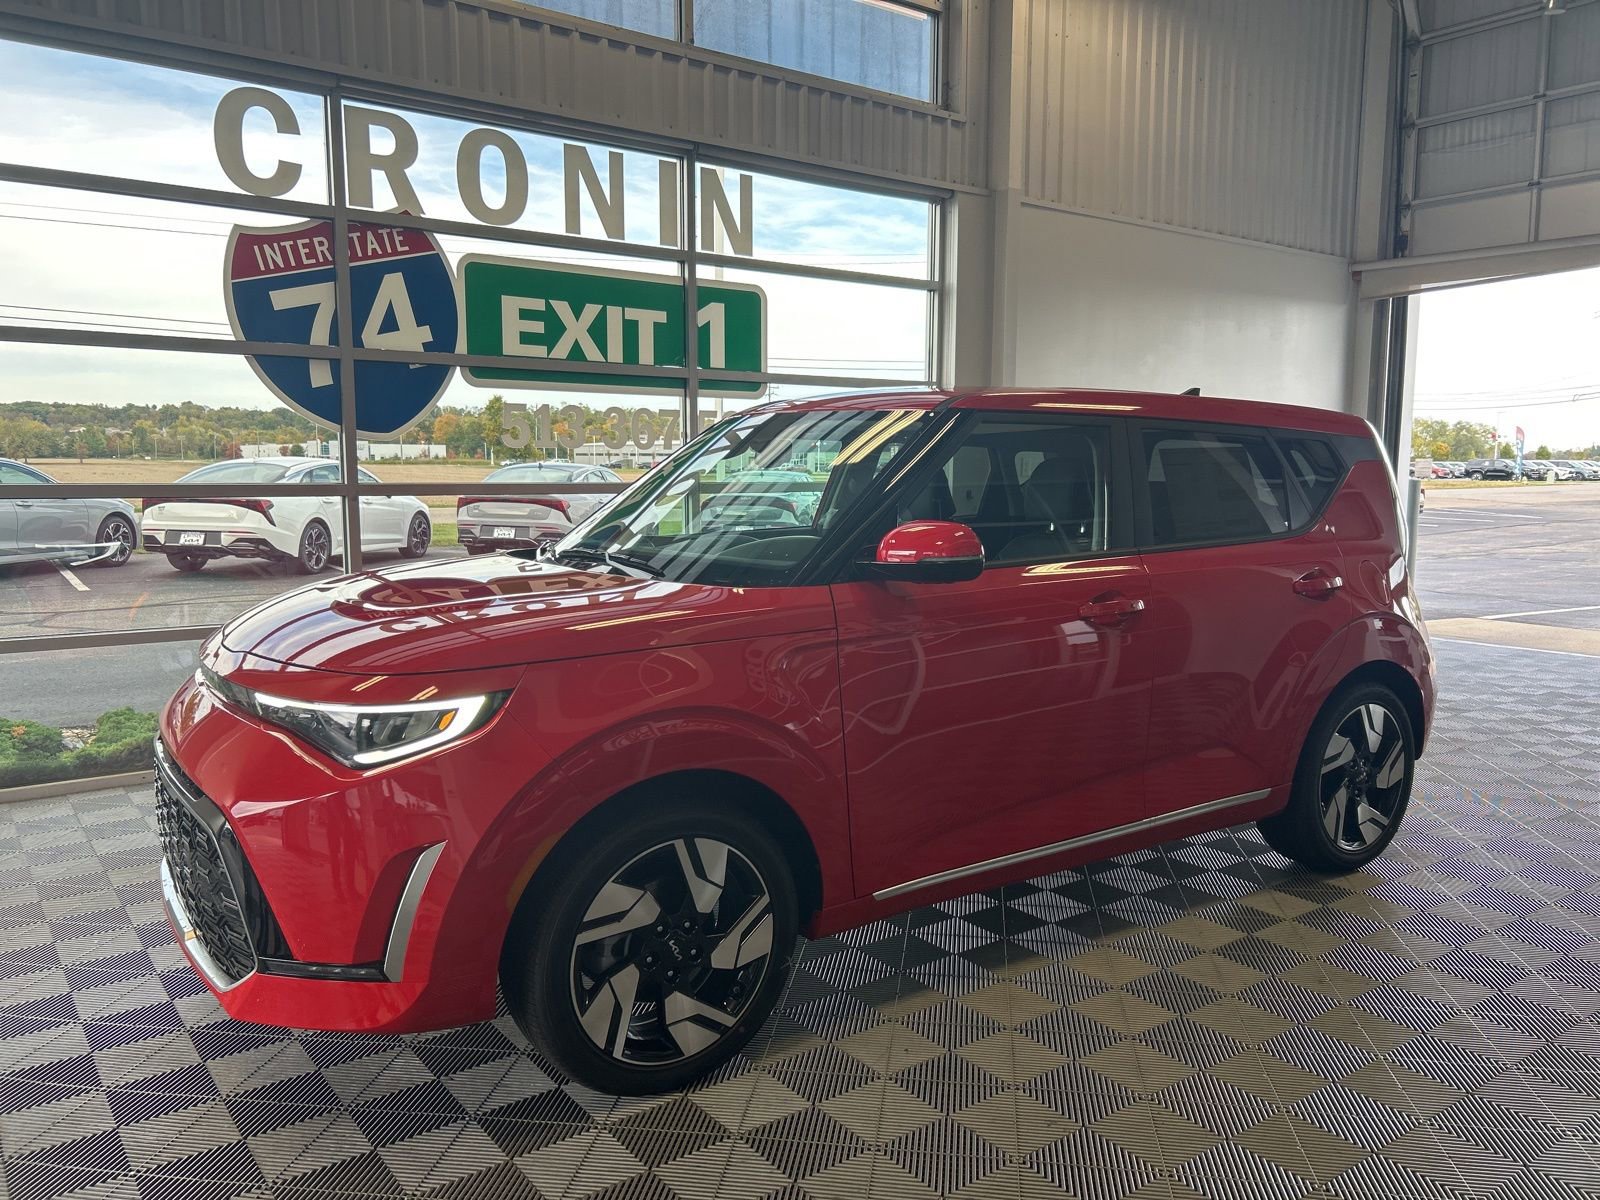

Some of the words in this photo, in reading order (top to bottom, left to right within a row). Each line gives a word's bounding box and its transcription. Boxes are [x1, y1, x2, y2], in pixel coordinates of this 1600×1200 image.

[213, 86, 754, 257] CRONIN
[253, 227, 410, 272] INTERTATE
[268, 271, 434, 389] 74
[501, 294, 668, 367] EXIT
[697, 302, 726, 369] 1
